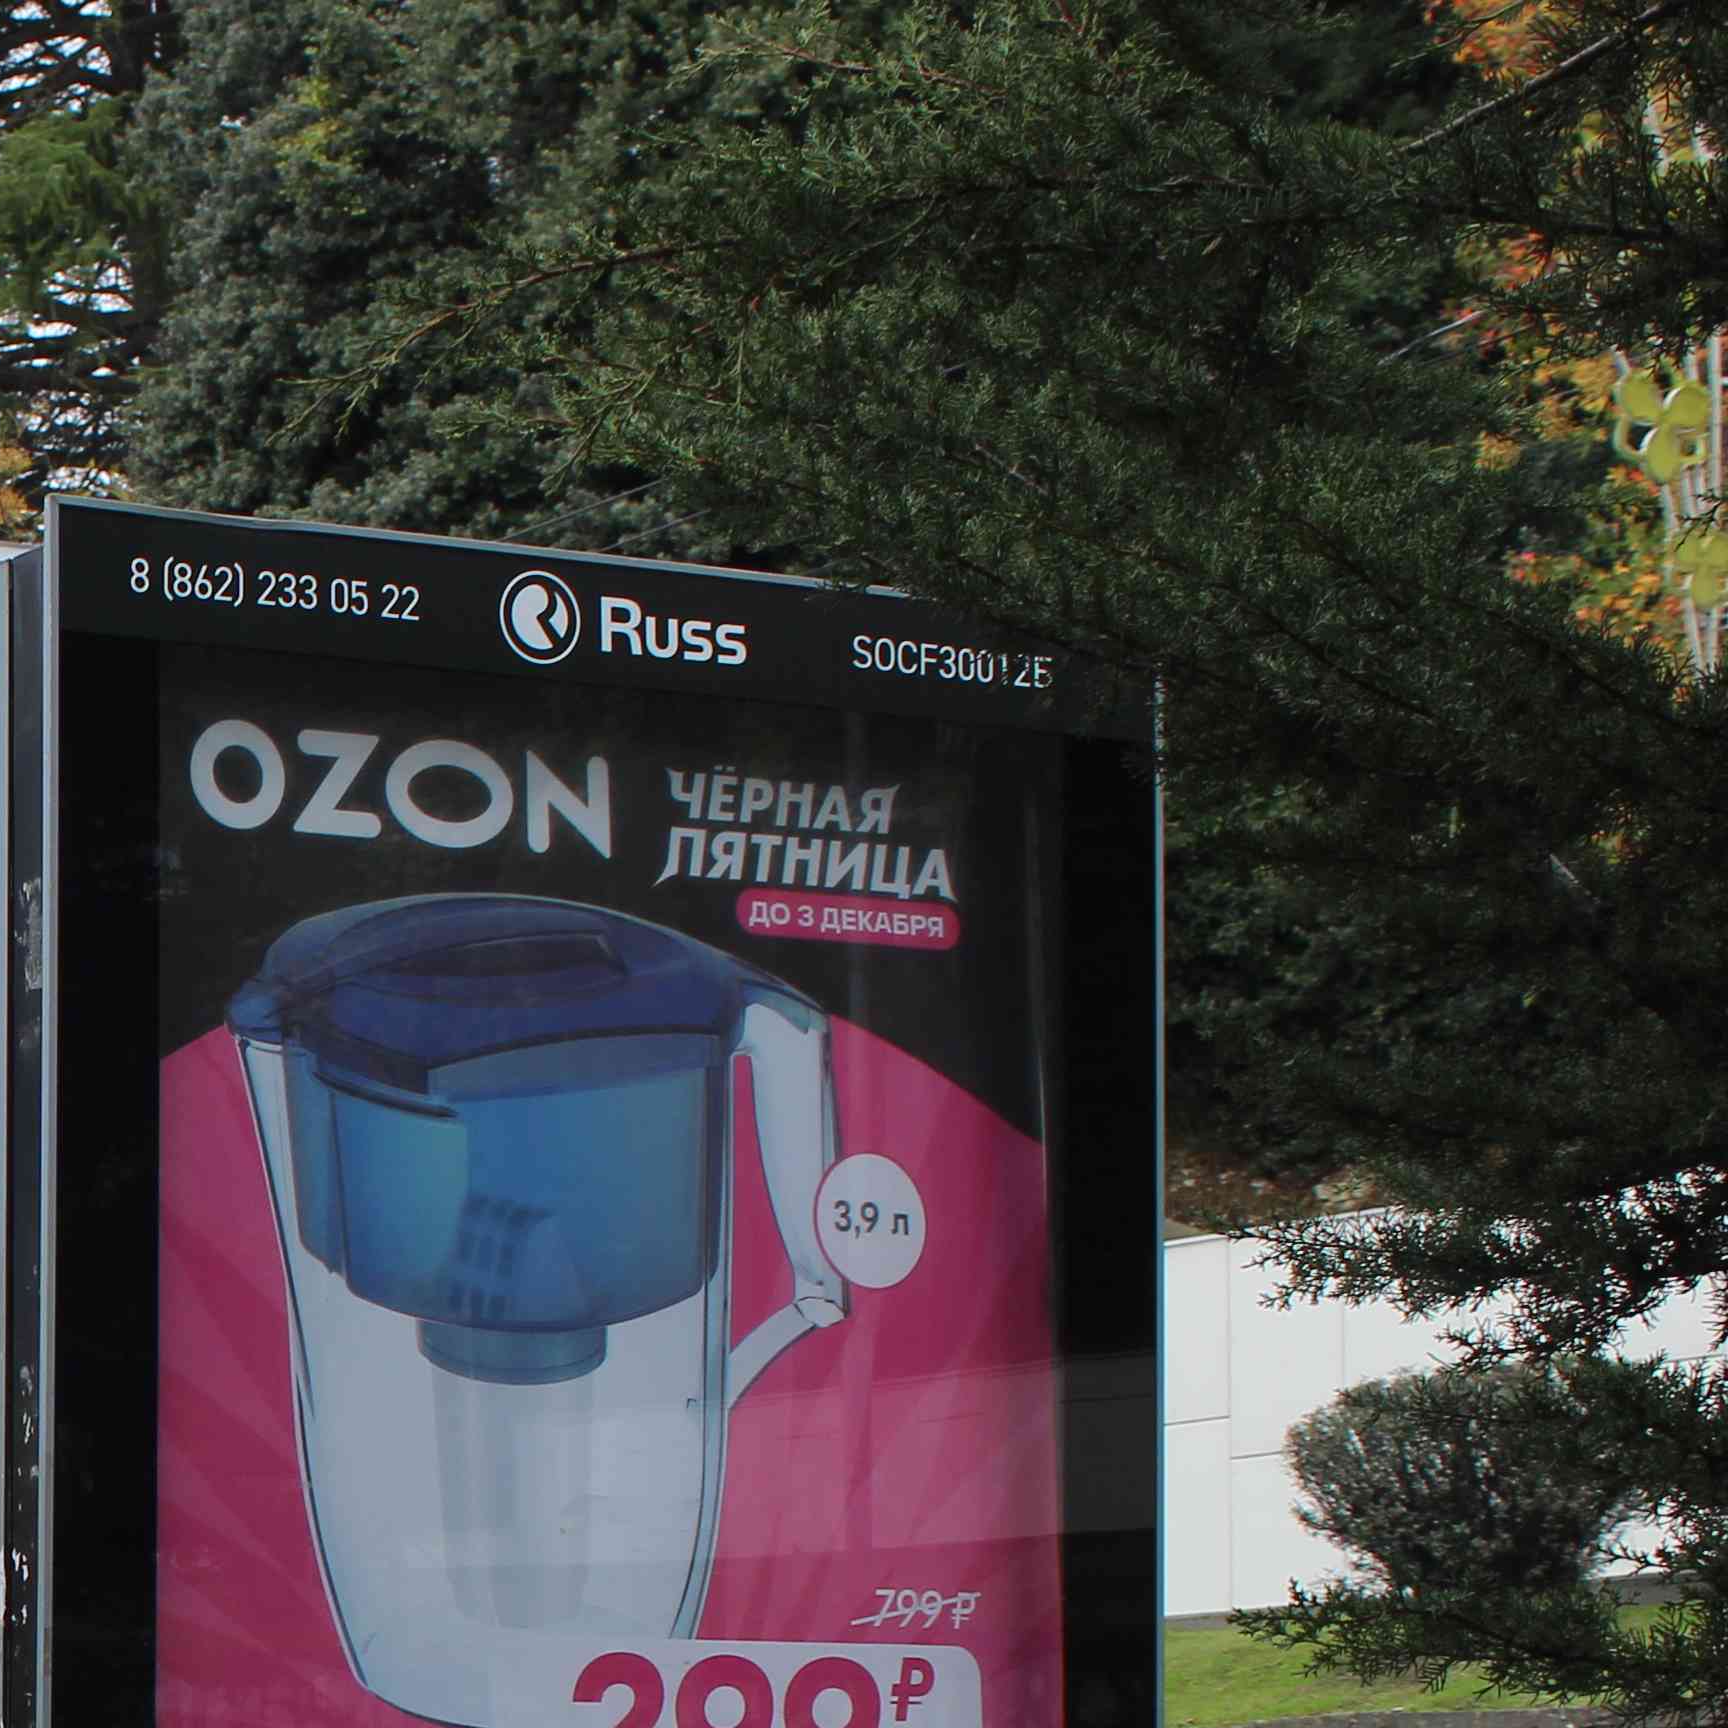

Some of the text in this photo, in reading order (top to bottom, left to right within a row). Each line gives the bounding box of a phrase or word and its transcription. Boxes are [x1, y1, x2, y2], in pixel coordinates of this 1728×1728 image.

[130, 556, 420, 621] 8 (862) 233 05 22
[600, 596, 748, 665] Russ
[190, 718, 613, 860] OZON
[665, 765, 901, 834] ЧЁРНАЯ
[651, 826, 958, 904] ПЯТНИЦА
[748, 900, 945, 938] ДО 3 ДЕКАБРЯ
[833, 1200, 910, 1238] 3,9 л
